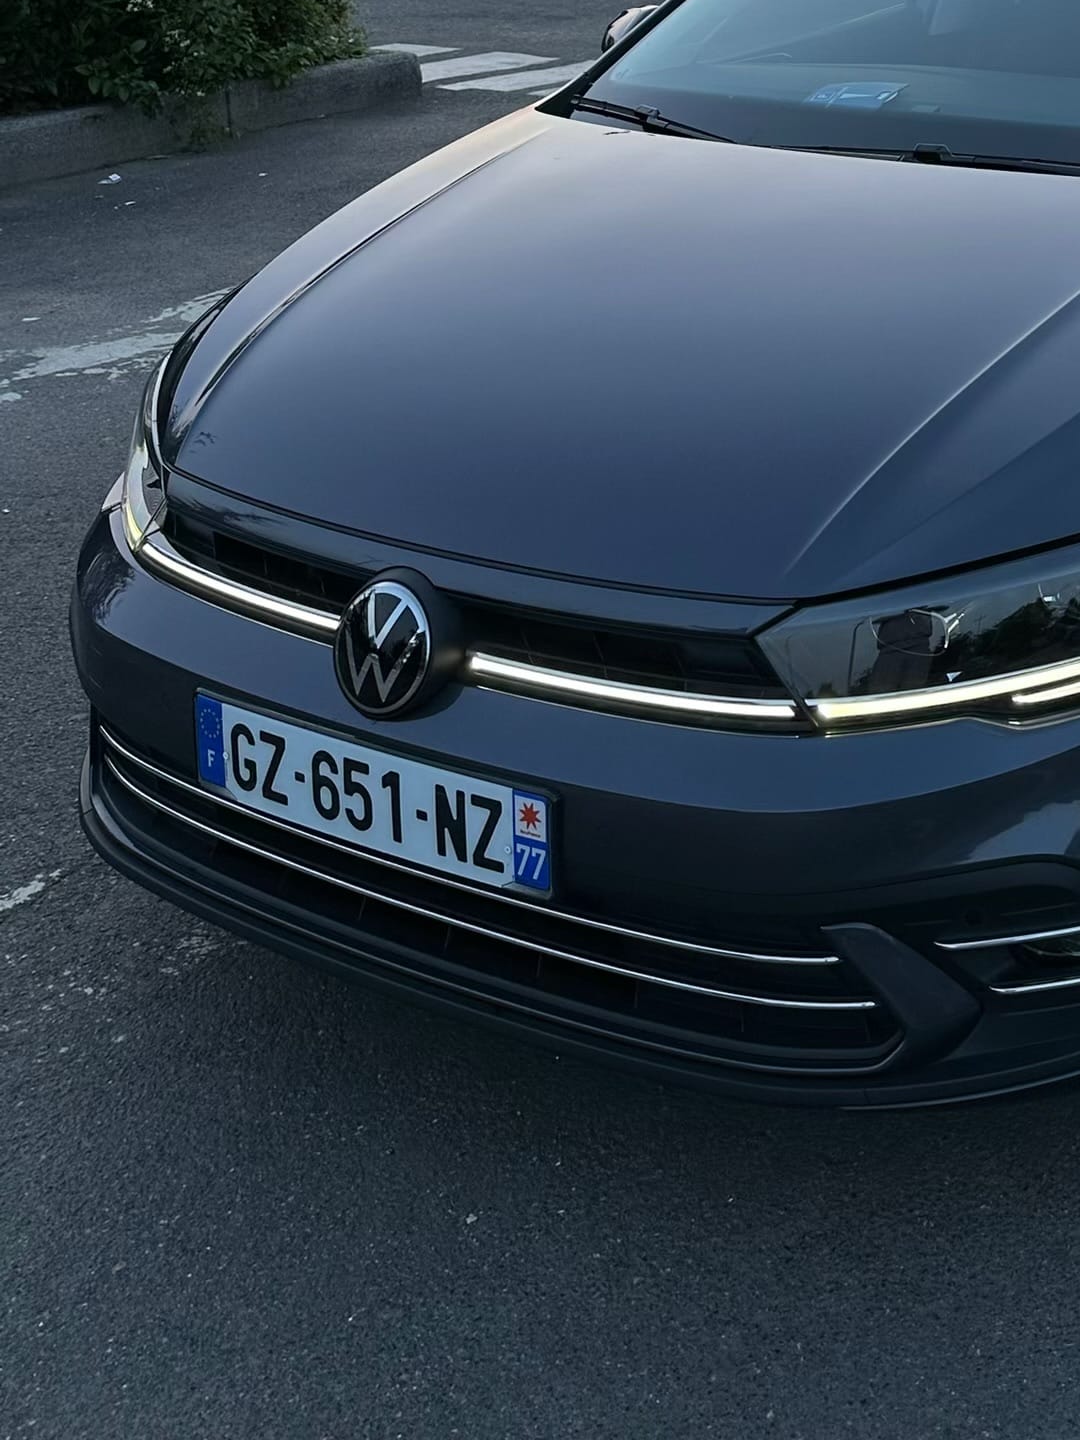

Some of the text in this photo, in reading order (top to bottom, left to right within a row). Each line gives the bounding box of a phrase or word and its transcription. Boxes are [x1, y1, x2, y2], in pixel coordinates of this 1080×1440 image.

[206, 749, 216, 768] F
[229, 722, 505, 874] GZ-651-NZ
[515, 842, 547, 881] 77
